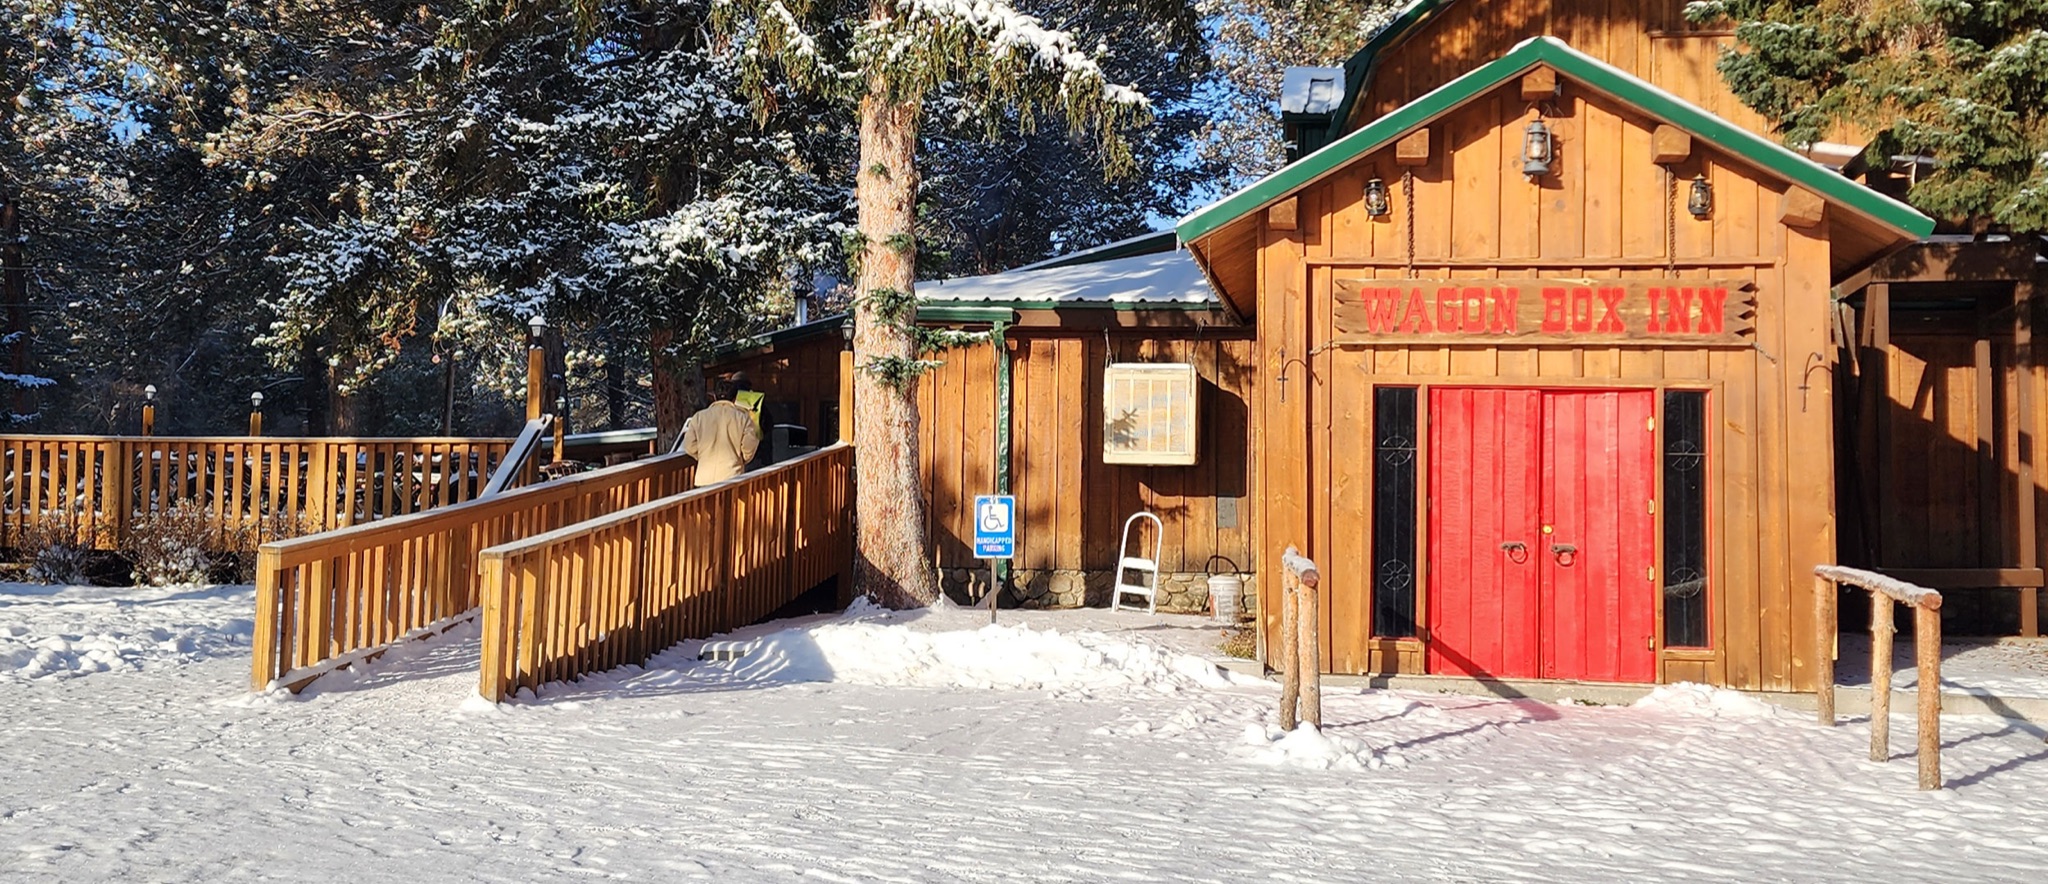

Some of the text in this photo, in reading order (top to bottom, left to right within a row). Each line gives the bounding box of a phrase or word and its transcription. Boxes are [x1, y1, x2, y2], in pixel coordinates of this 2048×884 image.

[1360, 286, 1729, 335] WAGON BOX INN
[976, 536, 1012, 544] HANDICAPPED
